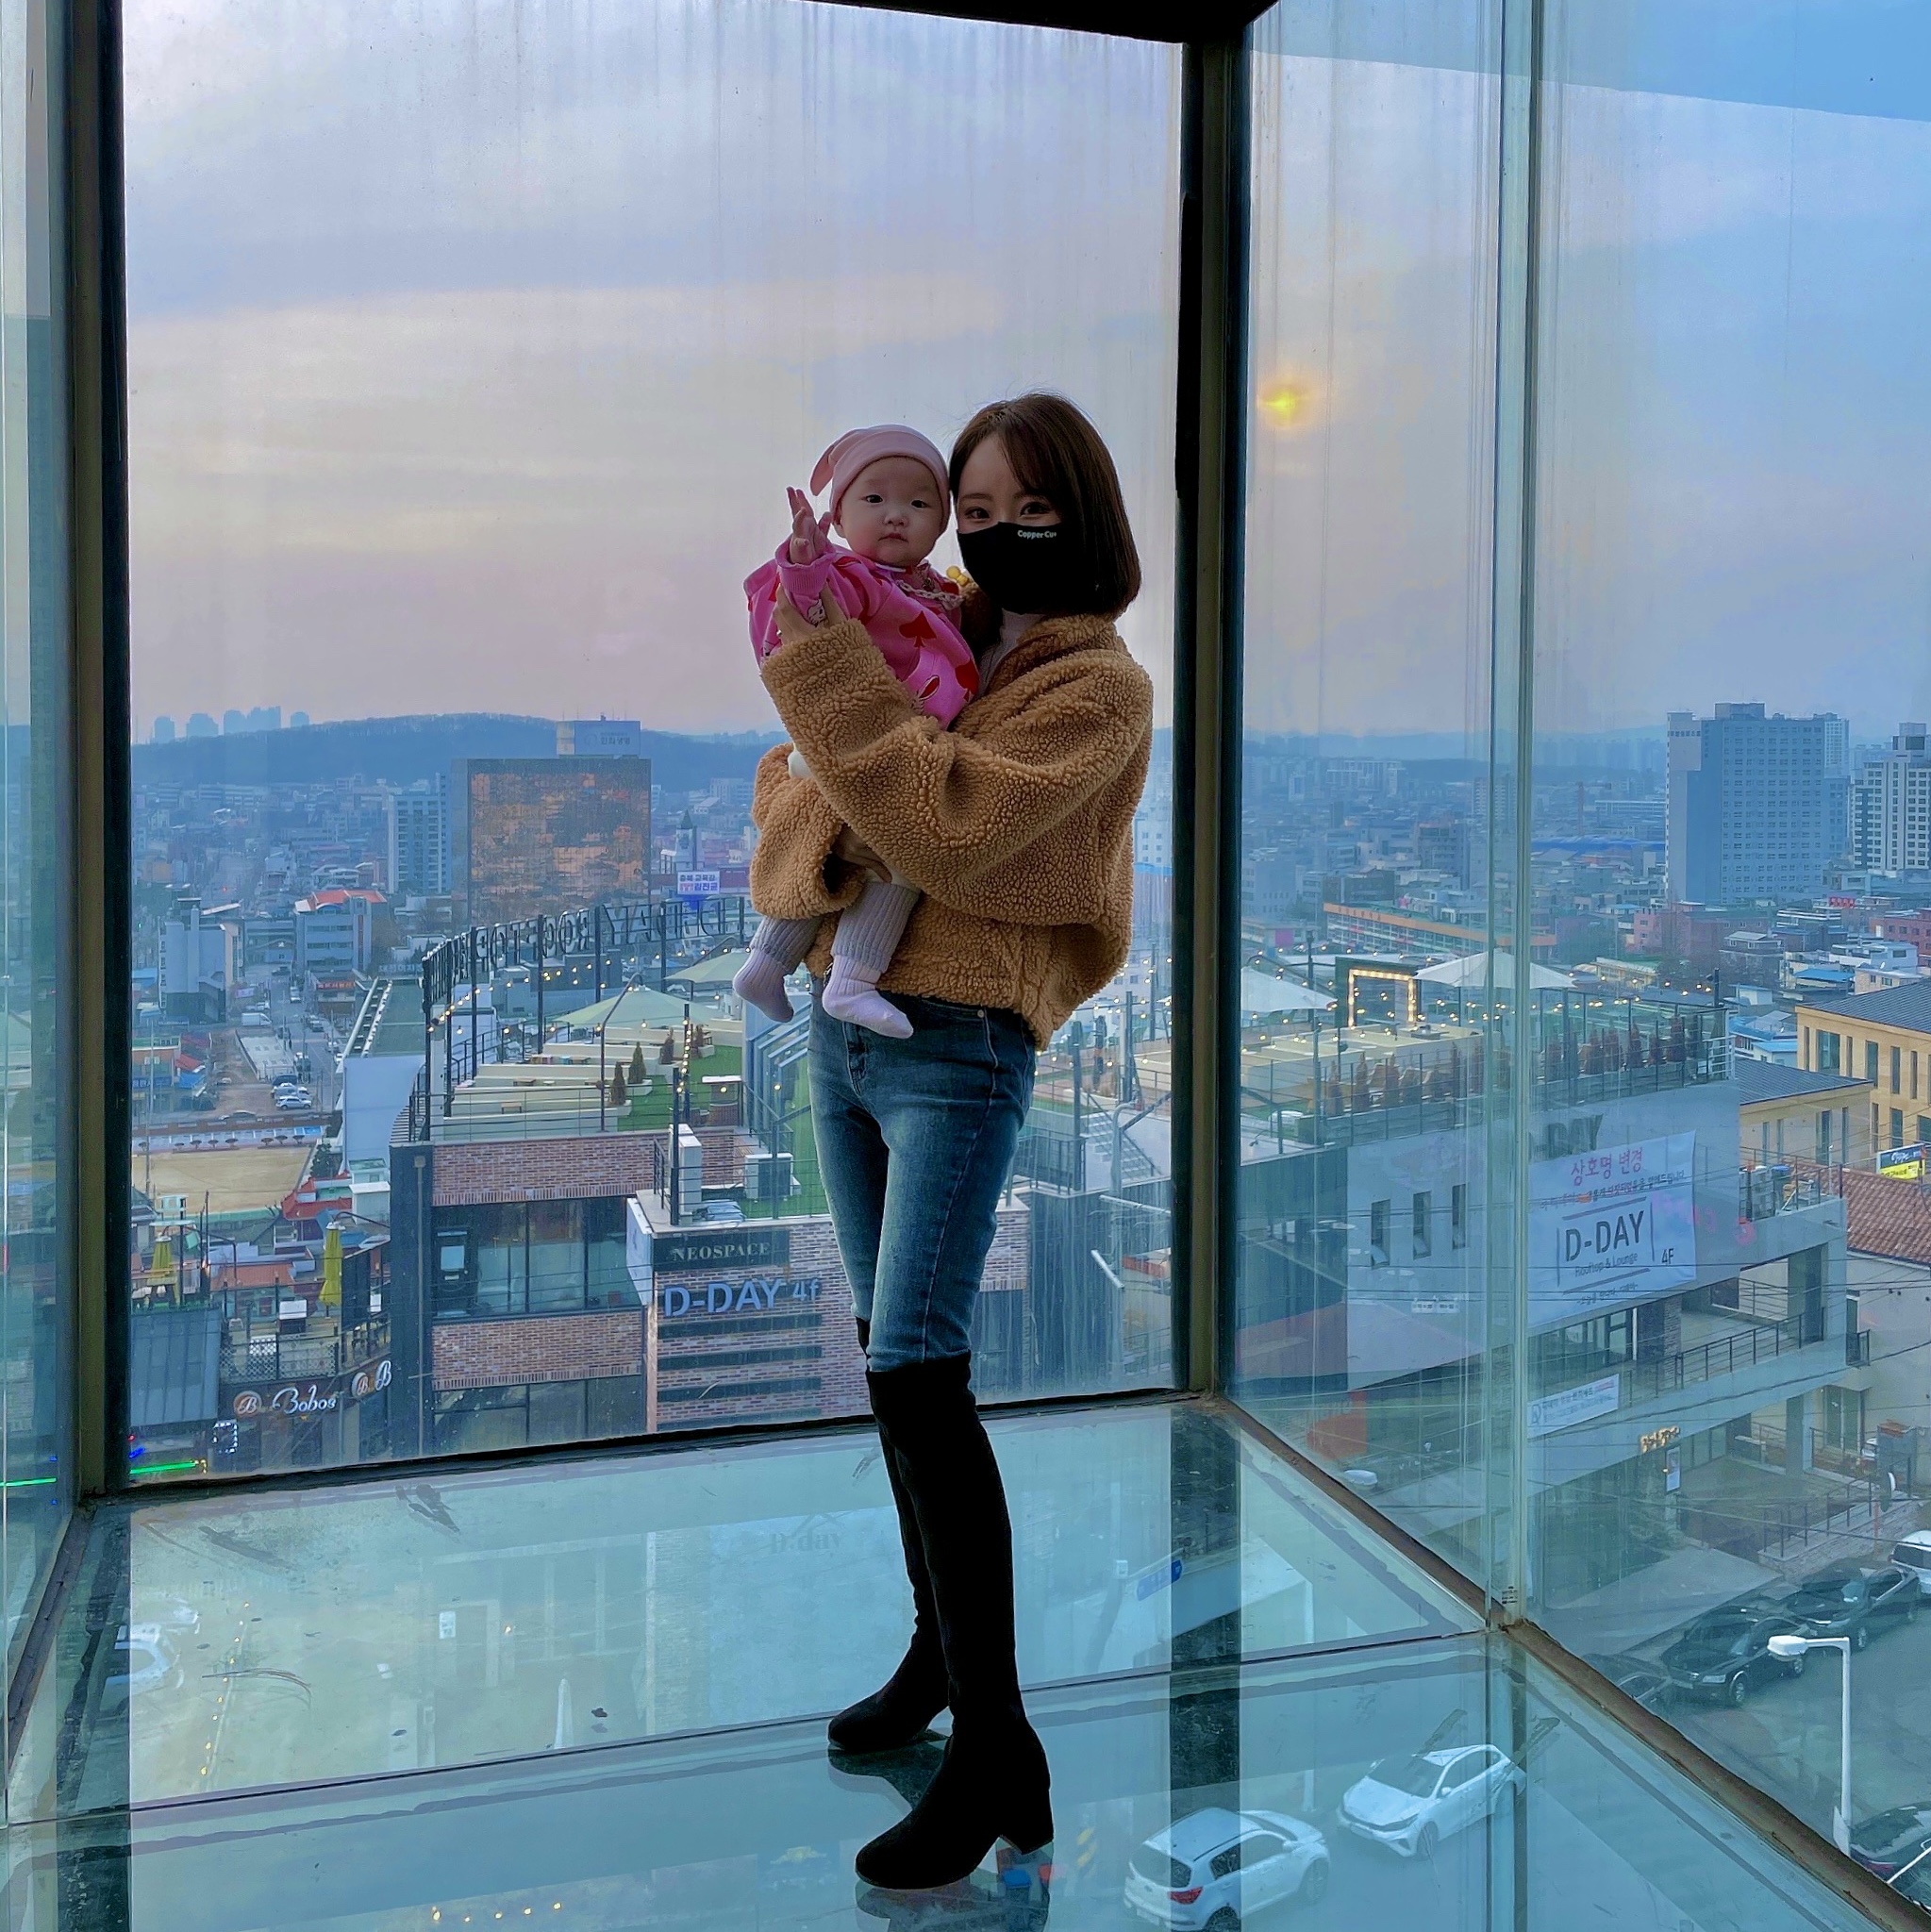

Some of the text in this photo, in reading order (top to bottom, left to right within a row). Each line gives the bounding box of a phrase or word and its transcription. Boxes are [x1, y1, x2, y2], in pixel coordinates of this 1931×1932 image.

[1017, 529, 1044, 540] Copper
[1571, 1147, 1643, 1187] 상호명 변경
[1565, 1210, 1645, 1262] D-DAY
[672, 1241, 771, 1262] NEOSPACE
[1661, 1247, 1674, 1265] 4F
[664, 1278, 782, 1317] D-DAY
